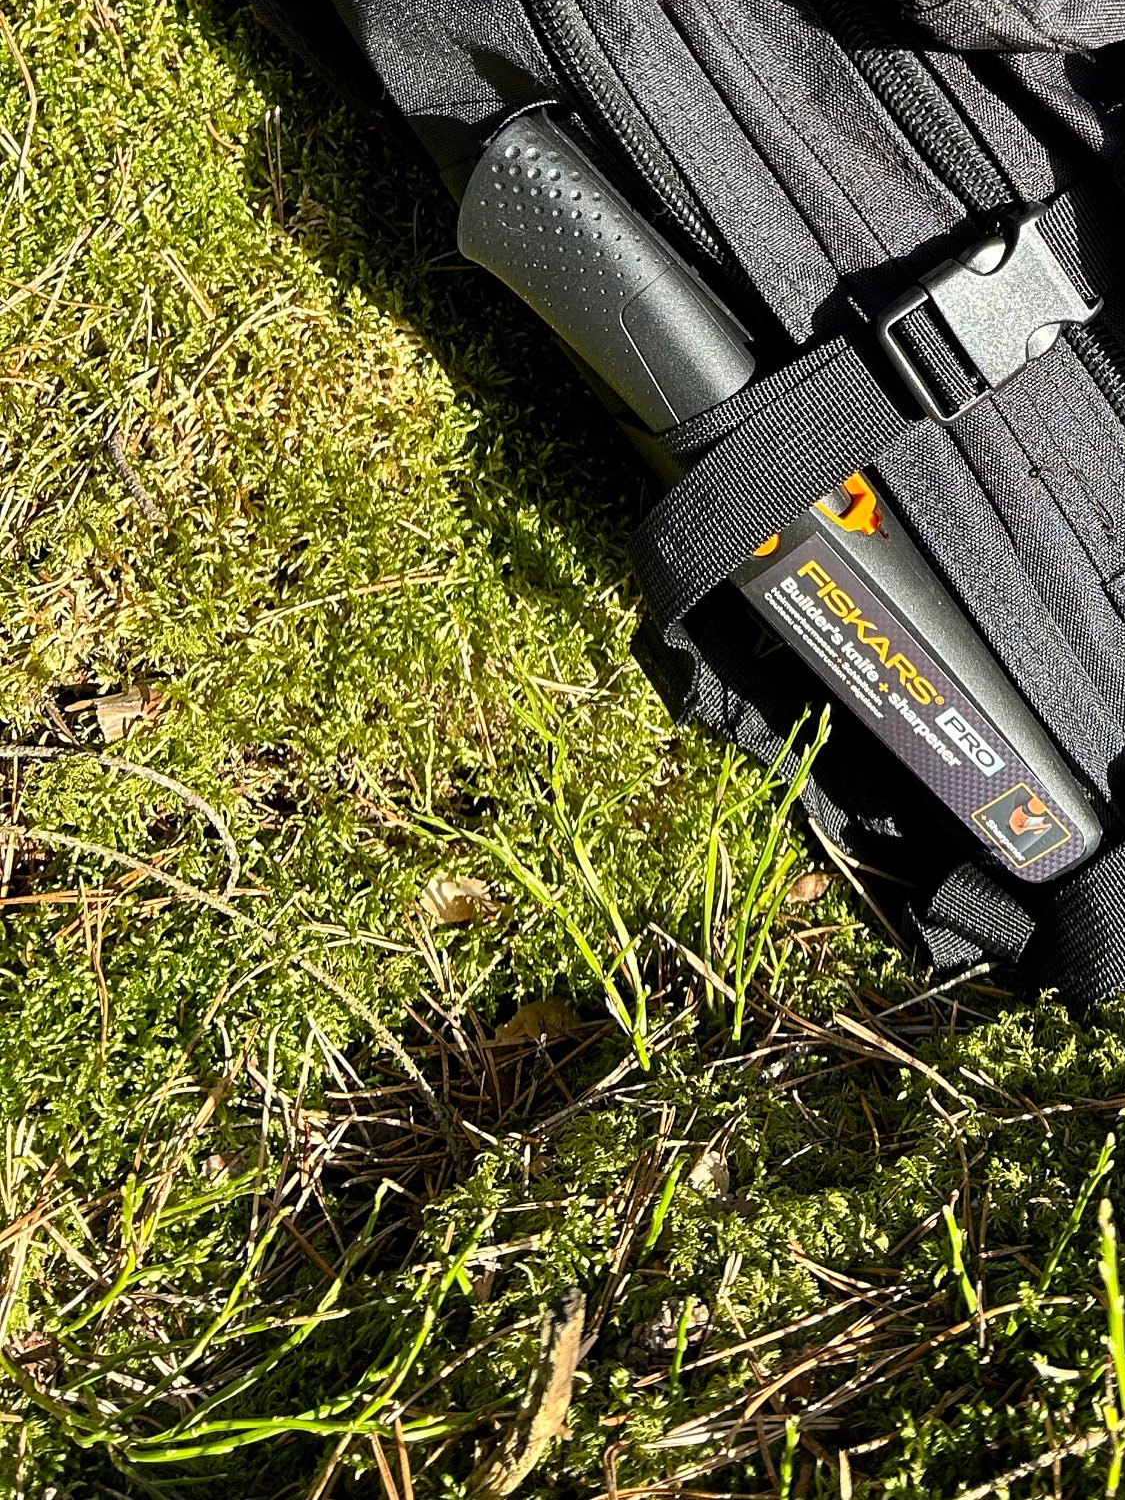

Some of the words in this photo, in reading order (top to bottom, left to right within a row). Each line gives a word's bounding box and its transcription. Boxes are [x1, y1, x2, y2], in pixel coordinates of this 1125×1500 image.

[763, 592, 795, 626] Couteau
[792, 622, 804, 636] de
[802, 631, 847, 682] construction
[779, 576, 844, 646] Builder's
[840, 640, 880, 683] knife
[887, 692, 962, 767] sharpener
[943, 715, 996, 768] PRO
[985, 818, 1026, 862] Sharpener
